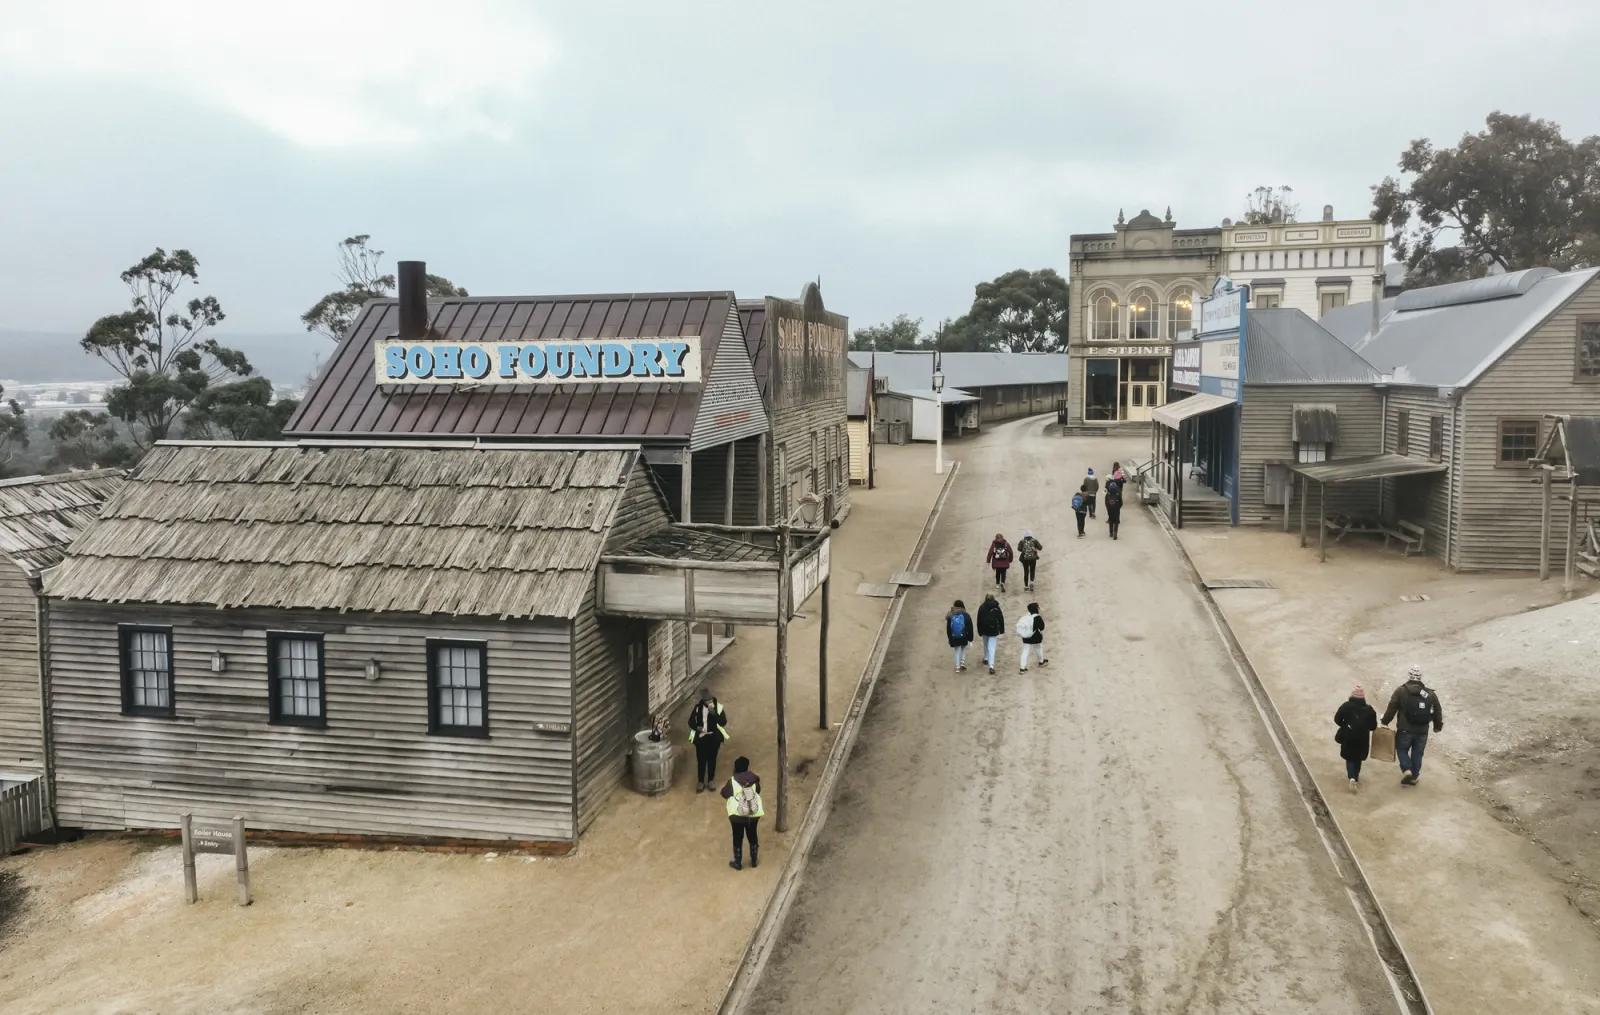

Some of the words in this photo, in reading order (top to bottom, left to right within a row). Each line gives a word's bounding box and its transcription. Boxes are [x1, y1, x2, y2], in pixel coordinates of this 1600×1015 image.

[778, 316, 805, 352] SOHO
[385, 345, 491, 380] SOHO
[497, 342, 690, 379] FOUNDRY
